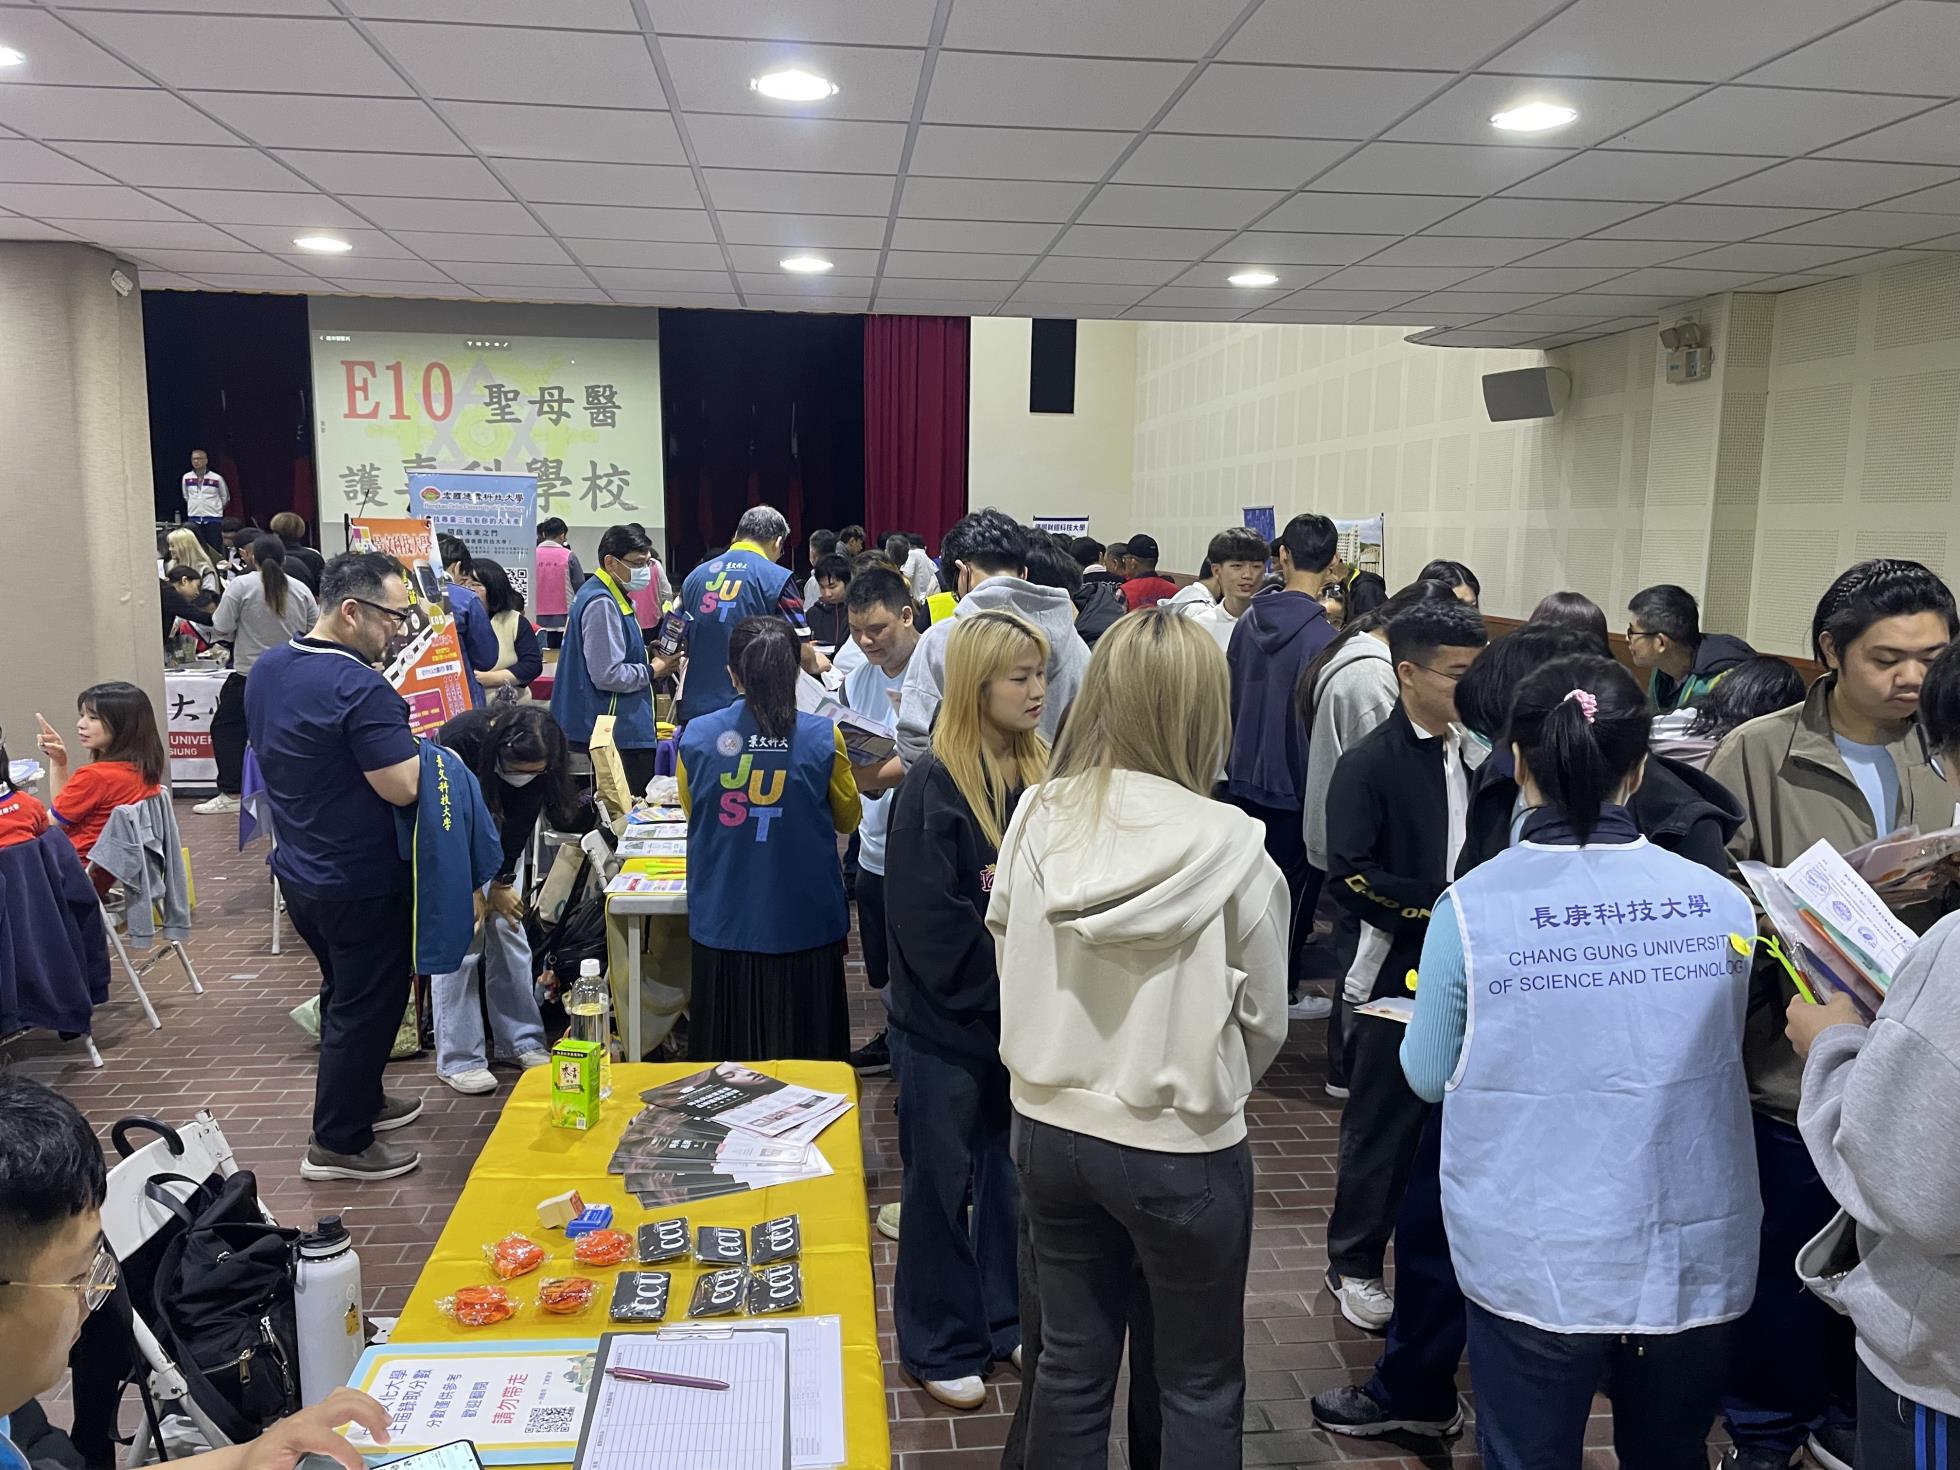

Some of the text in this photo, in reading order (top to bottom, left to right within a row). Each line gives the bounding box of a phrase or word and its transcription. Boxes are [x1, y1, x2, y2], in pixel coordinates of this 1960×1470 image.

[340, 360, 622, 428] E10 聖母醫
[169, 748, 198, 756] SIUNG
[747, 734, 789, 748] 景文科大
[436, 754, 452, 831] 景文科技大學
[1529, 894, 1712, 930] 長庚科技大學
[1508, 934, 1729, 967] CHANG GUNG UNIVERSIT
[1488, 959, 1744, 996] OF SCIENCE AND TECHNOLOG
[660, 1218, 682, 1250] CCU
[718, 1227, 743, 1257] CCU
[771, 1216, 794, 1252] CCU
[636, 1271, 664, 1310] CCU
[711, 1268, 742, 1304] CCU
[770, 1264, 794, 1299] CCU
[390, 1369, 433, 1435] 上屆錄取分數
[491, 1373, 529, 1424] 請勿帶走
